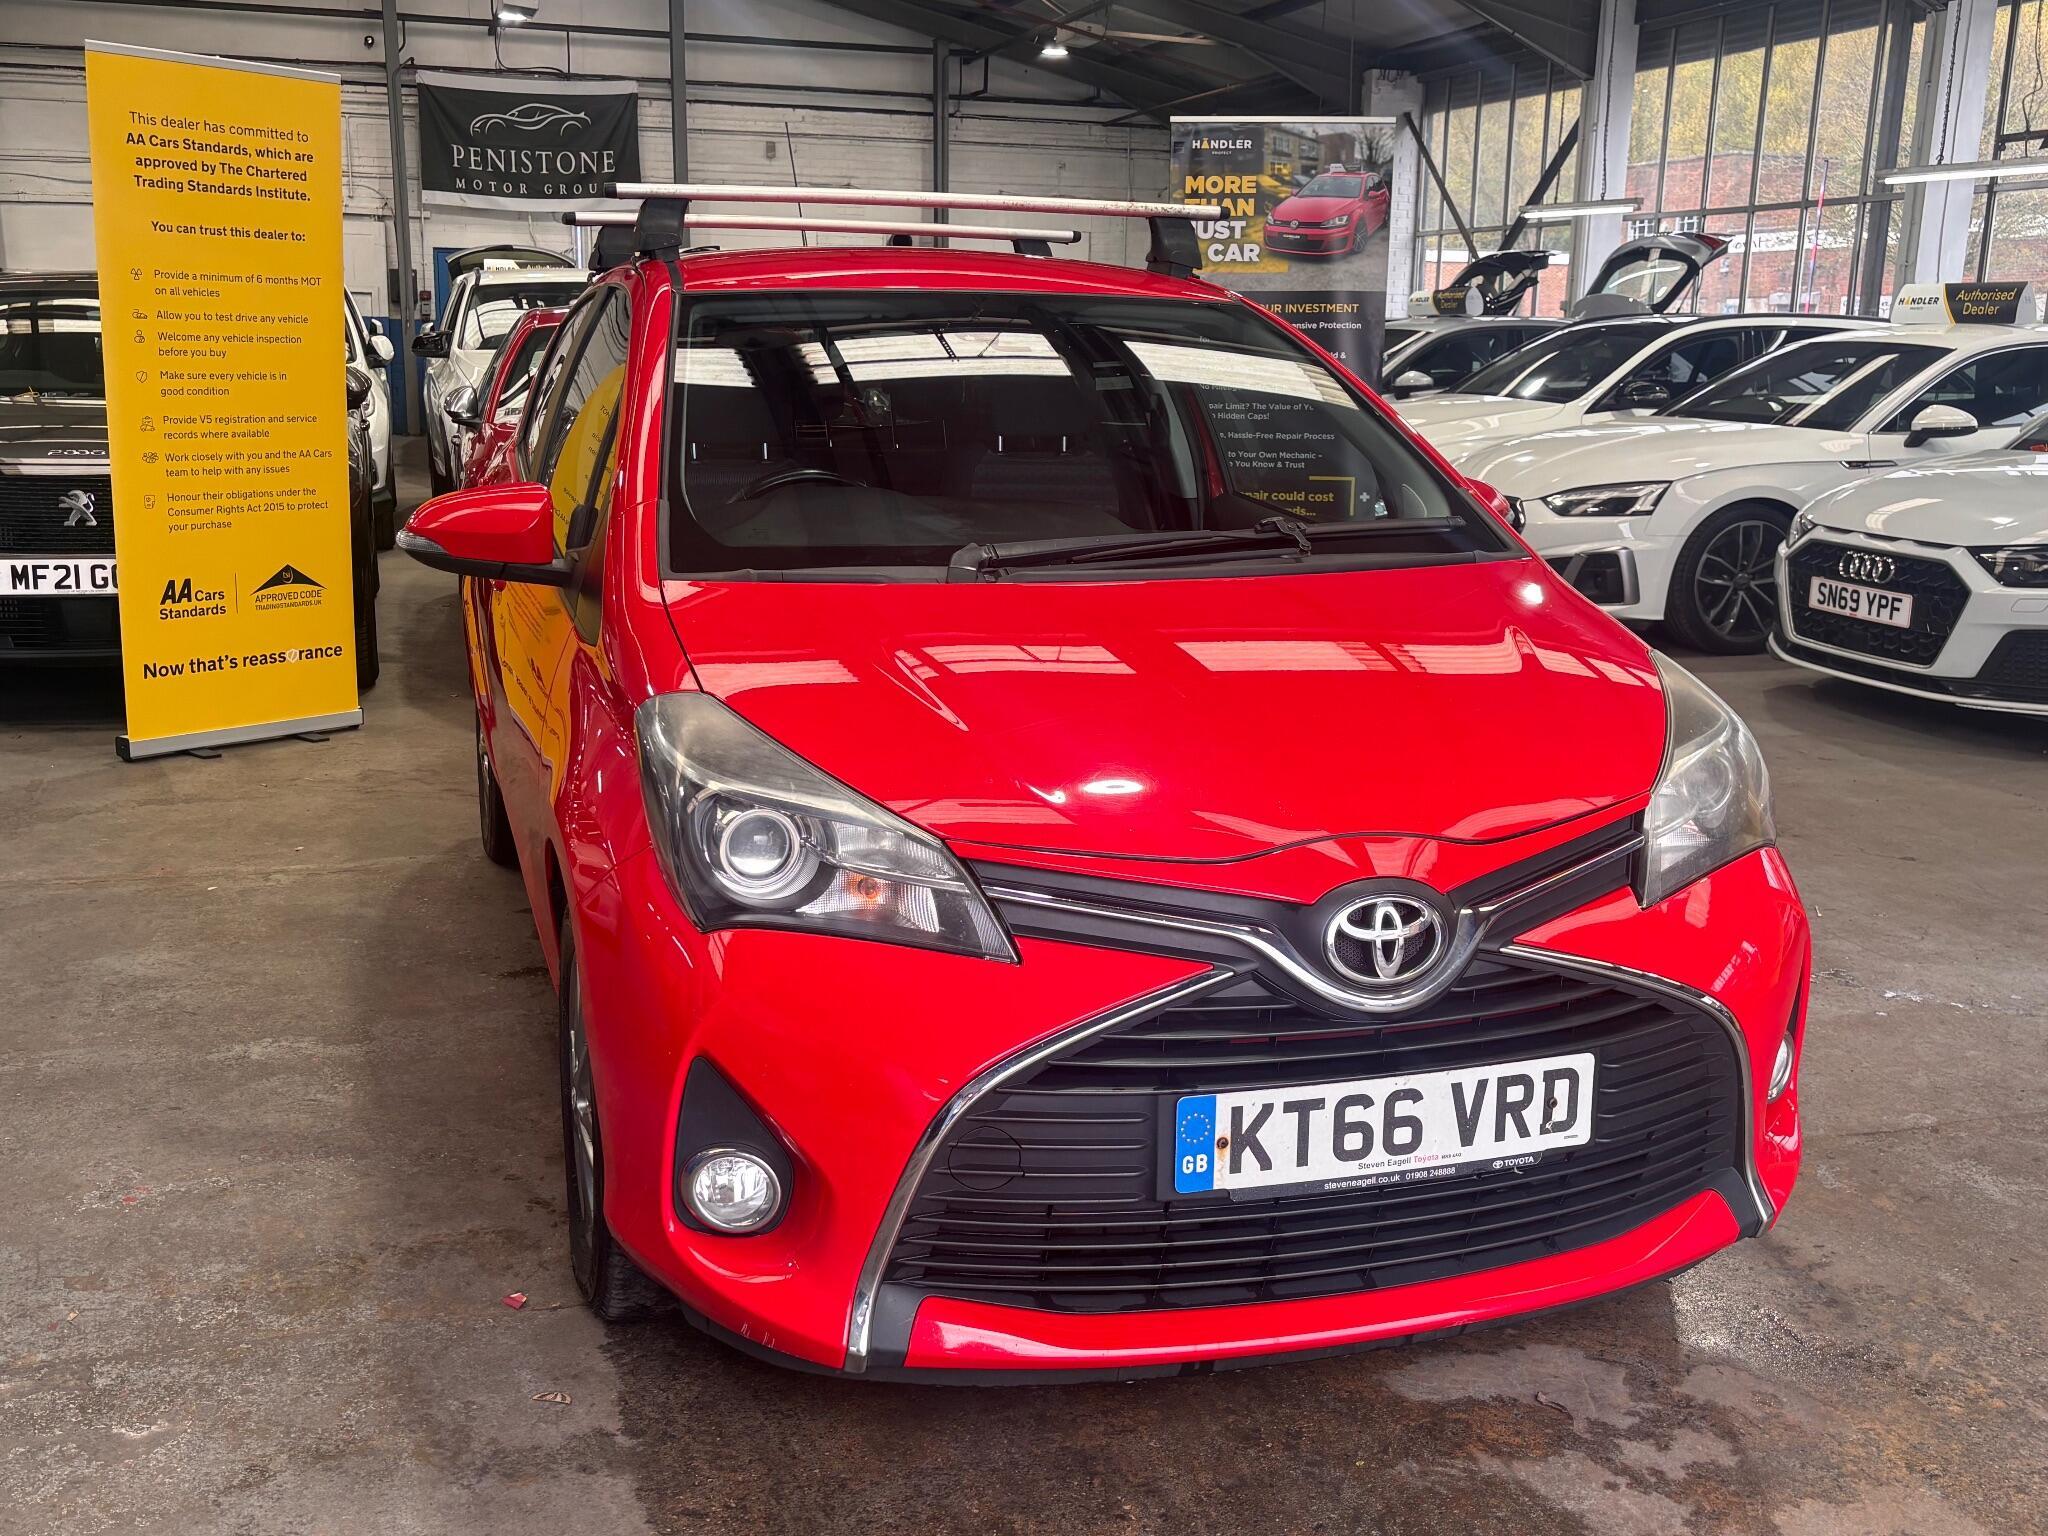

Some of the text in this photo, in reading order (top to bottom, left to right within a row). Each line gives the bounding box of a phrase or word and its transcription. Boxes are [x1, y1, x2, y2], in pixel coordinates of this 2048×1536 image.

[129, 111, 308, 142] This dealer has committed to
[126, 133, 313, 162] AA Cars Standards, which are
[451, 144, 615, 174] PENISTONE
[136, 157, 306, 181] approved by The Chartered
[134, 175, 310, 201] Trading Standards Institute.
[456, 178, 597, 194] MOTOR GROU
[1185, 176, 1256, 194] MORE
[151, 221, 305, 241] You can trust this dealer to:
[1208, 244, 1260, 262] CAR
[154, 270, 189, 280] Provide
[200, 273, 242, 282] minimum
[245, 274, 254, 283] of
[257, 275, 262, 283] 6
[266, 277, 298, 285] months
[301, 277, 321, 286] MOT
[170, 287, 180, 296] all
[182, 288, 220, 297] vehicles
[1956, 289, 2017, 300] Authorised
[1285, 304, 1359, 312] INVESTMENT
[1963, 303, 1999, 314] Dealer
[157, 310, 308, 324] Allow you to test drive any vehicle
[158, 332, 301, 344] Welcome any vehicle inspection
[159, 347, 226, 358] before you buy
[160, 371, 184, 379] Make
[209, 373, 234, 382] every
[237, 372, 267, 380] vehicle
[270, 372, 277, 380] is
[161, 387, 229, 397] good condition
[163, 416, 197, 424] Provide
[200, 415, 212, 423] V5
[215, 415, 265, 425] registration
[268, 415, 284, 423] and
[164, 429, 269, 439] records where available
[165, 449, 332, 462] Work closely with you and the AA Cars
[166, 465, 289, 477] team to help with any issues
[167, 493, 200, 502] Honour
[203, 491, 223, 500] their
[226, 490, 273, 500] obligations
[276, 488, 300, 497] under
[1272, 492, 1305, 500] could
[1308, 493, 1334, 501] cost
[168, 508, 213, 516] Consumer
[217, 505, 244, 515] Rights
[247, 504, 261, 512] Act
[264, 503, 284, 511] 2015
[298, 501, 328, 511] protect
[169, 520, 232, 533] your purchase
[10, 564, 80, 590] MF21
[160, 578, 224, 605] AA Cars
[255, 590, 322, 603] APPROVED CODE
[1817, 583, 1902, 620] SN69 YPF
[160, 604, 226, 620] Standards
[144, 661, 184, 680] Now
[243, 645, 342, 668] reassrance
[1229, 1067, 1580, 1174] KT66 VRD
[1182, 1154, 1208, 1173] GB
[1358, 1161, 1385, 1170] Steven
[1387, 1158, 1411, 1167] Eagell
[1414, 1154, 1439, 1163] Toyota
[1504, 1156, 1534, 1167] TOYOTA
[1324, 1167, 1456, 1190] steveneagell.co.uk 01908 248888
